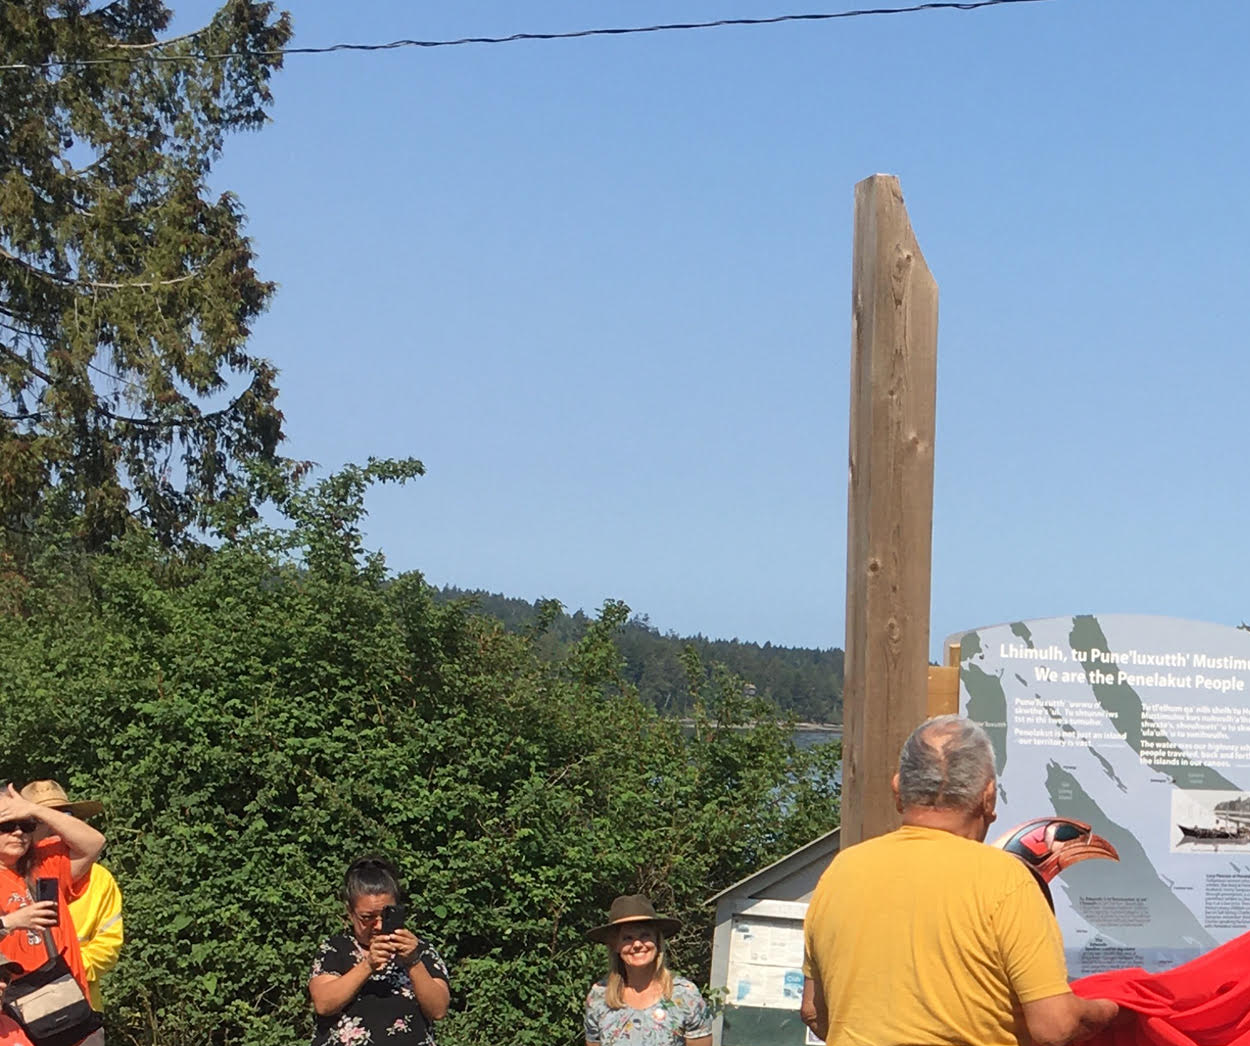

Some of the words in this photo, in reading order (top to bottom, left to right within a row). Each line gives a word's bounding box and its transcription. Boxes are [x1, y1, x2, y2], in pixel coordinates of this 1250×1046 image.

[1072, 648, 1087, 661] tu
[1034, 666, 1058, 682] We
[1061, 672, 1086, 683] are
[1089, 669, 1114, 684] the
[1118, 671, 1192, 688] Penelakut
[1195, 674, 1245, 693] People
